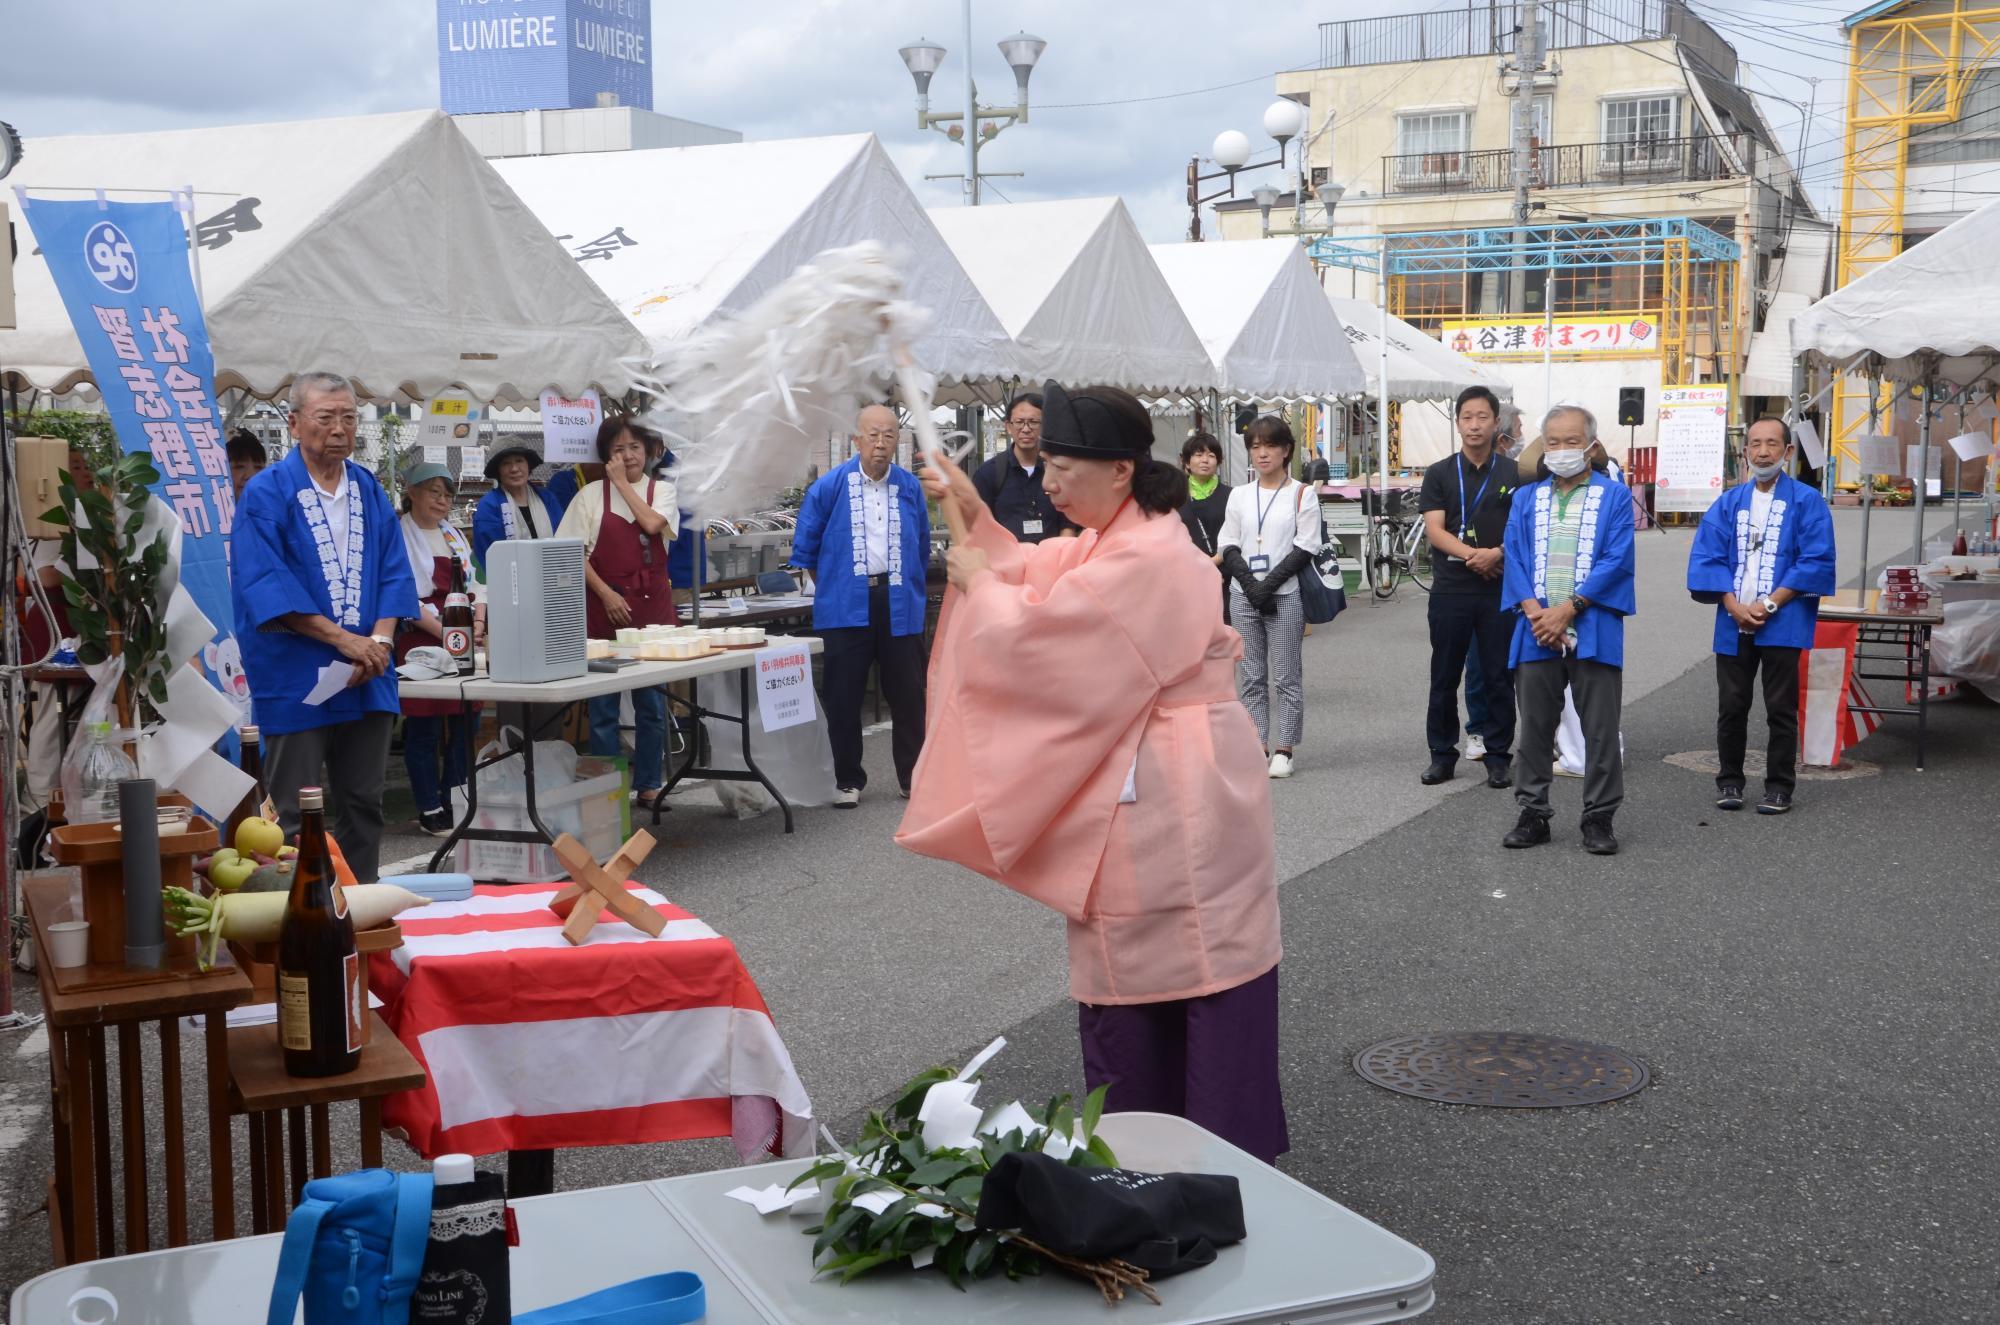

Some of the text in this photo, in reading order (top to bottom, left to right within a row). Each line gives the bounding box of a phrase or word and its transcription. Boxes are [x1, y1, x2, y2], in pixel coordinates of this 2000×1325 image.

[448, 13, 557, 51] LUMIÈRE
[575, 17, 646, 64] LUMIÈRE
[1476, 323, 1621, 349] 谷津秋まつり
[297, 488, 346, 627] 谷津西部連合町
